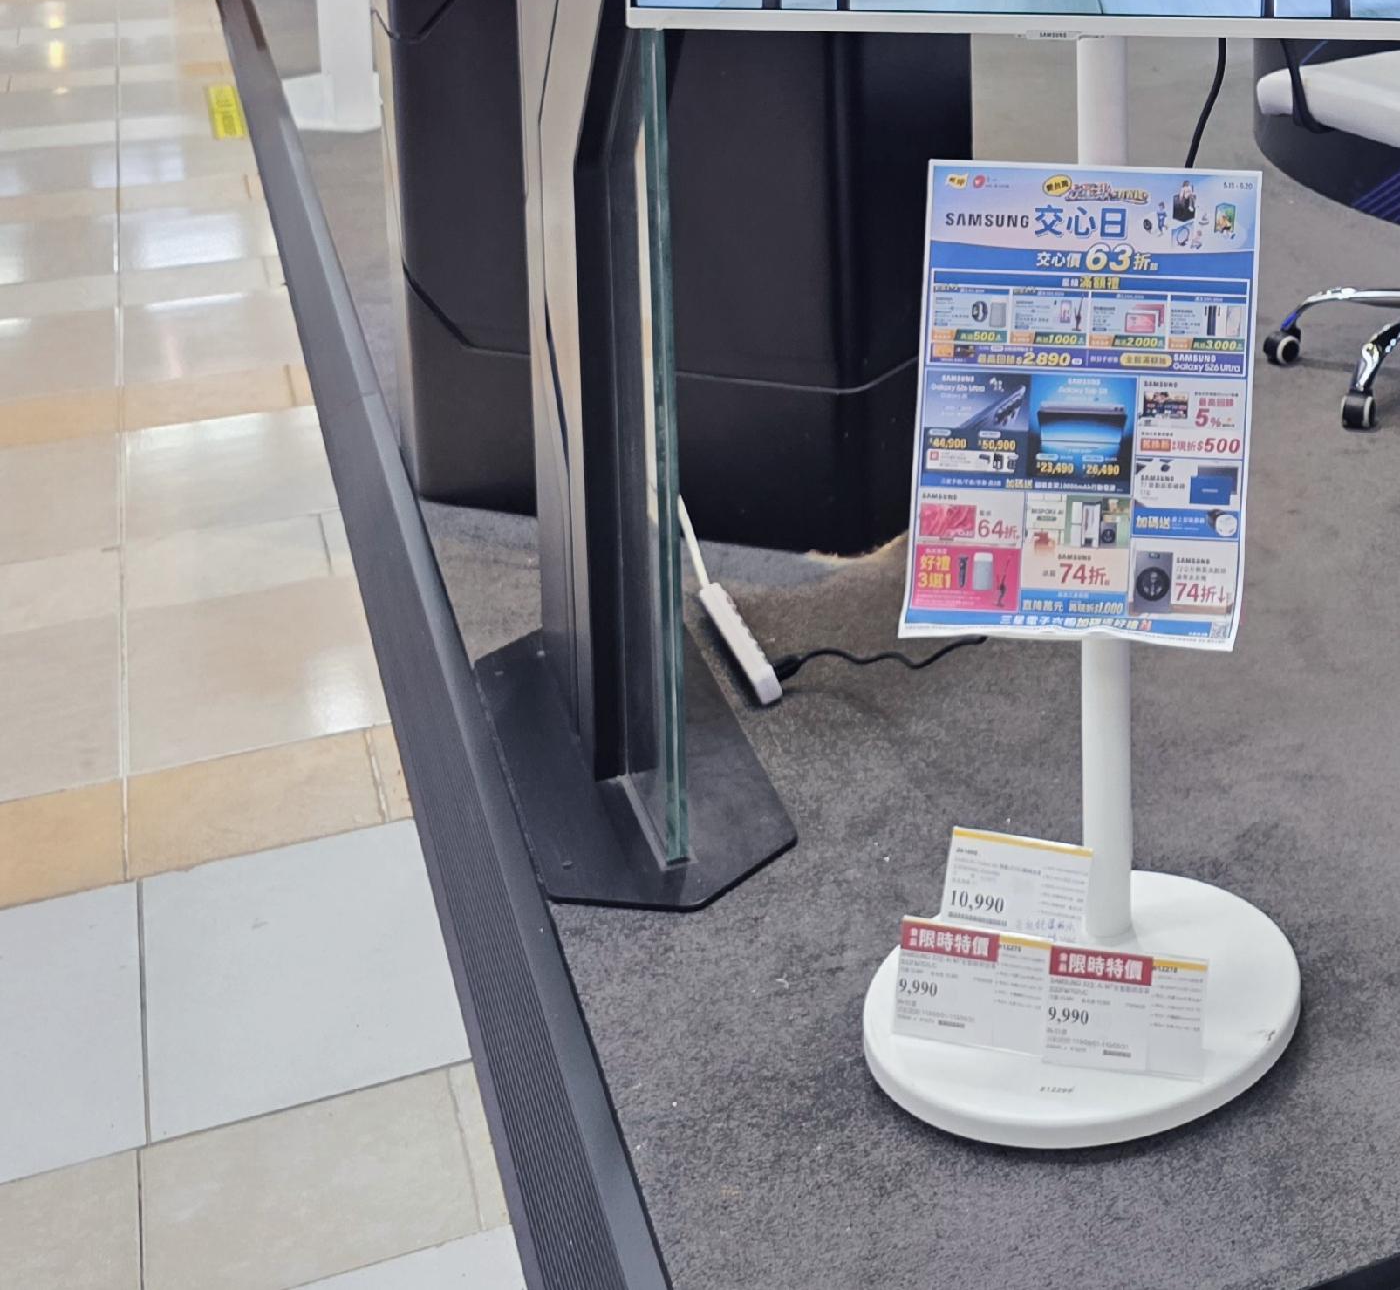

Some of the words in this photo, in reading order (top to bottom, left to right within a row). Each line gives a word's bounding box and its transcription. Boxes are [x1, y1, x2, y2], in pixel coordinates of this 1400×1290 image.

[945, 212, 1029, 229] SAMSUNG
[1034, 204, 1129, 240] 交心日
[950, 889, 1005, 914] 10,990
[918, 928, 991, 958] 限時特價
[1068, 953, 1144, 981] 限時特價
[898, 977, 939, 998] 9,990
[1047, 1006, 1090, 1026] 9,990
